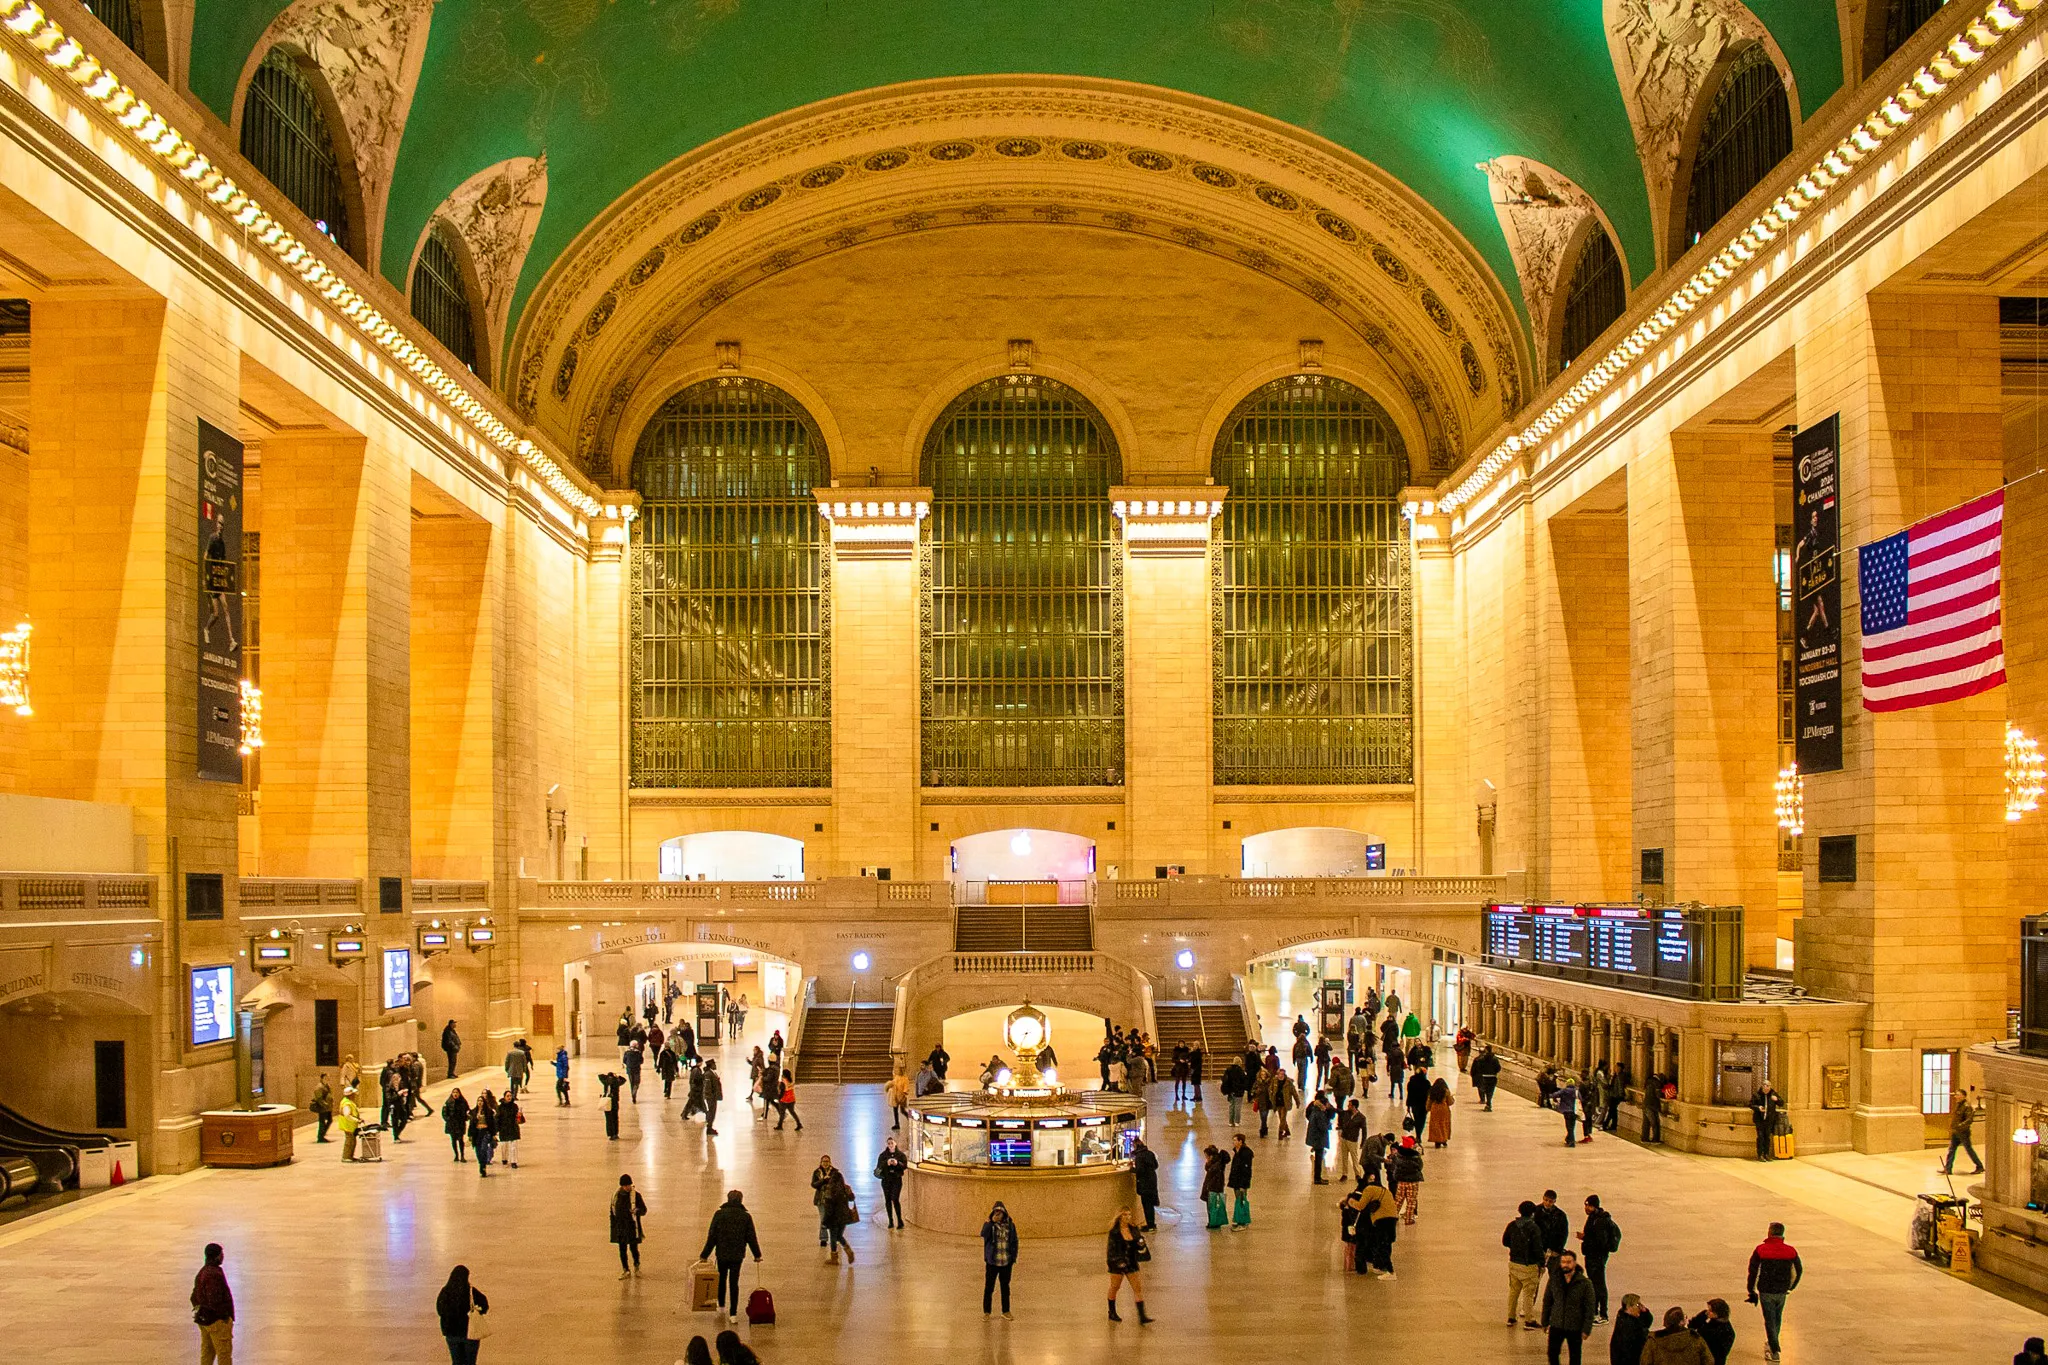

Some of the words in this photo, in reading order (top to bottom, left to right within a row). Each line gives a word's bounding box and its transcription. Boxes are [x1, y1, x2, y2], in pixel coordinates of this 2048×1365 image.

[1820, 473, 1834, 487] 2024
[1807, 484, 1834, 504] CHAMPION
[1800, 648, 1821, 661] JANUARY
[1799, 669, 1839, 687] TOCSQUASH.COM
[600, 937, 633, 950] TRACKS
[635, 935, 643, 943] 21
[646, 933, 658, 942] TO
[698, 932, 752, 947] LEXINGTON
[753, 941, 771, 950] AVE
[1277, 931, 1330, 947] LEXINGTON
[1332, 928, 1349, 936] AVE
[1381, 927, 1411, 937] TICKET
[1414, 931, 1459, 946] MACHINES
[653, 957, 672, 968] 42ND
[673, 953, 700, 963] STREET
[701, 951, 733, 960] PASSAGE
[1324, 947, 1356, 956] SUBWAY
[72, 972, 92, 984] 45TH
[93, 975, 122, 992] STREET
[1014, 1089, 1052, 1098] Information
